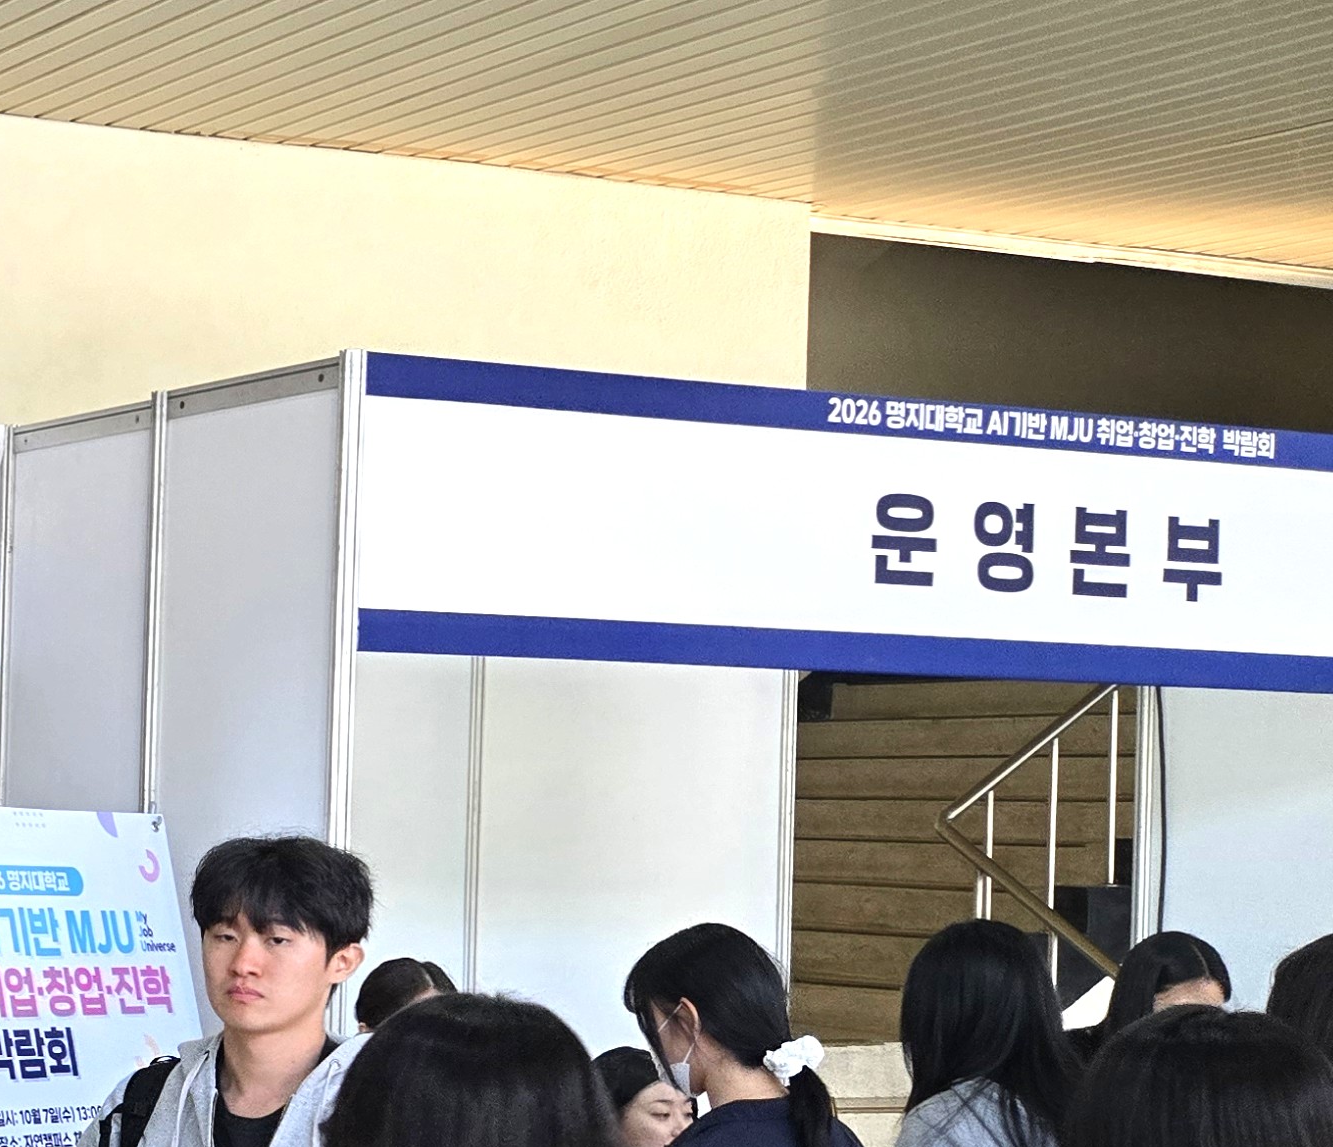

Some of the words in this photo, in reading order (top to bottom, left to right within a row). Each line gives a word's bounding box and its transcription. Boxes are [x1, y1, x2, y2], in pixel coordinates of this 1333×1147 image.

[827, 397, 881, 426] 2026
[885, 400, 983, 435] 명지대학교
[986, 410, 1047, 441] AI기반
[1050, 416, 1094, 443] MJU
[1096, 417, 1217, 455] 취업·창업·진학
[1222, 429, 1276, 460] 박람회
[6, 870, 71, 893] 명지대학교
[67, 909, 135, 955] MJU
[140, 939, 177, 953] Universe
[19, 1107, 42, 1125] 10월
